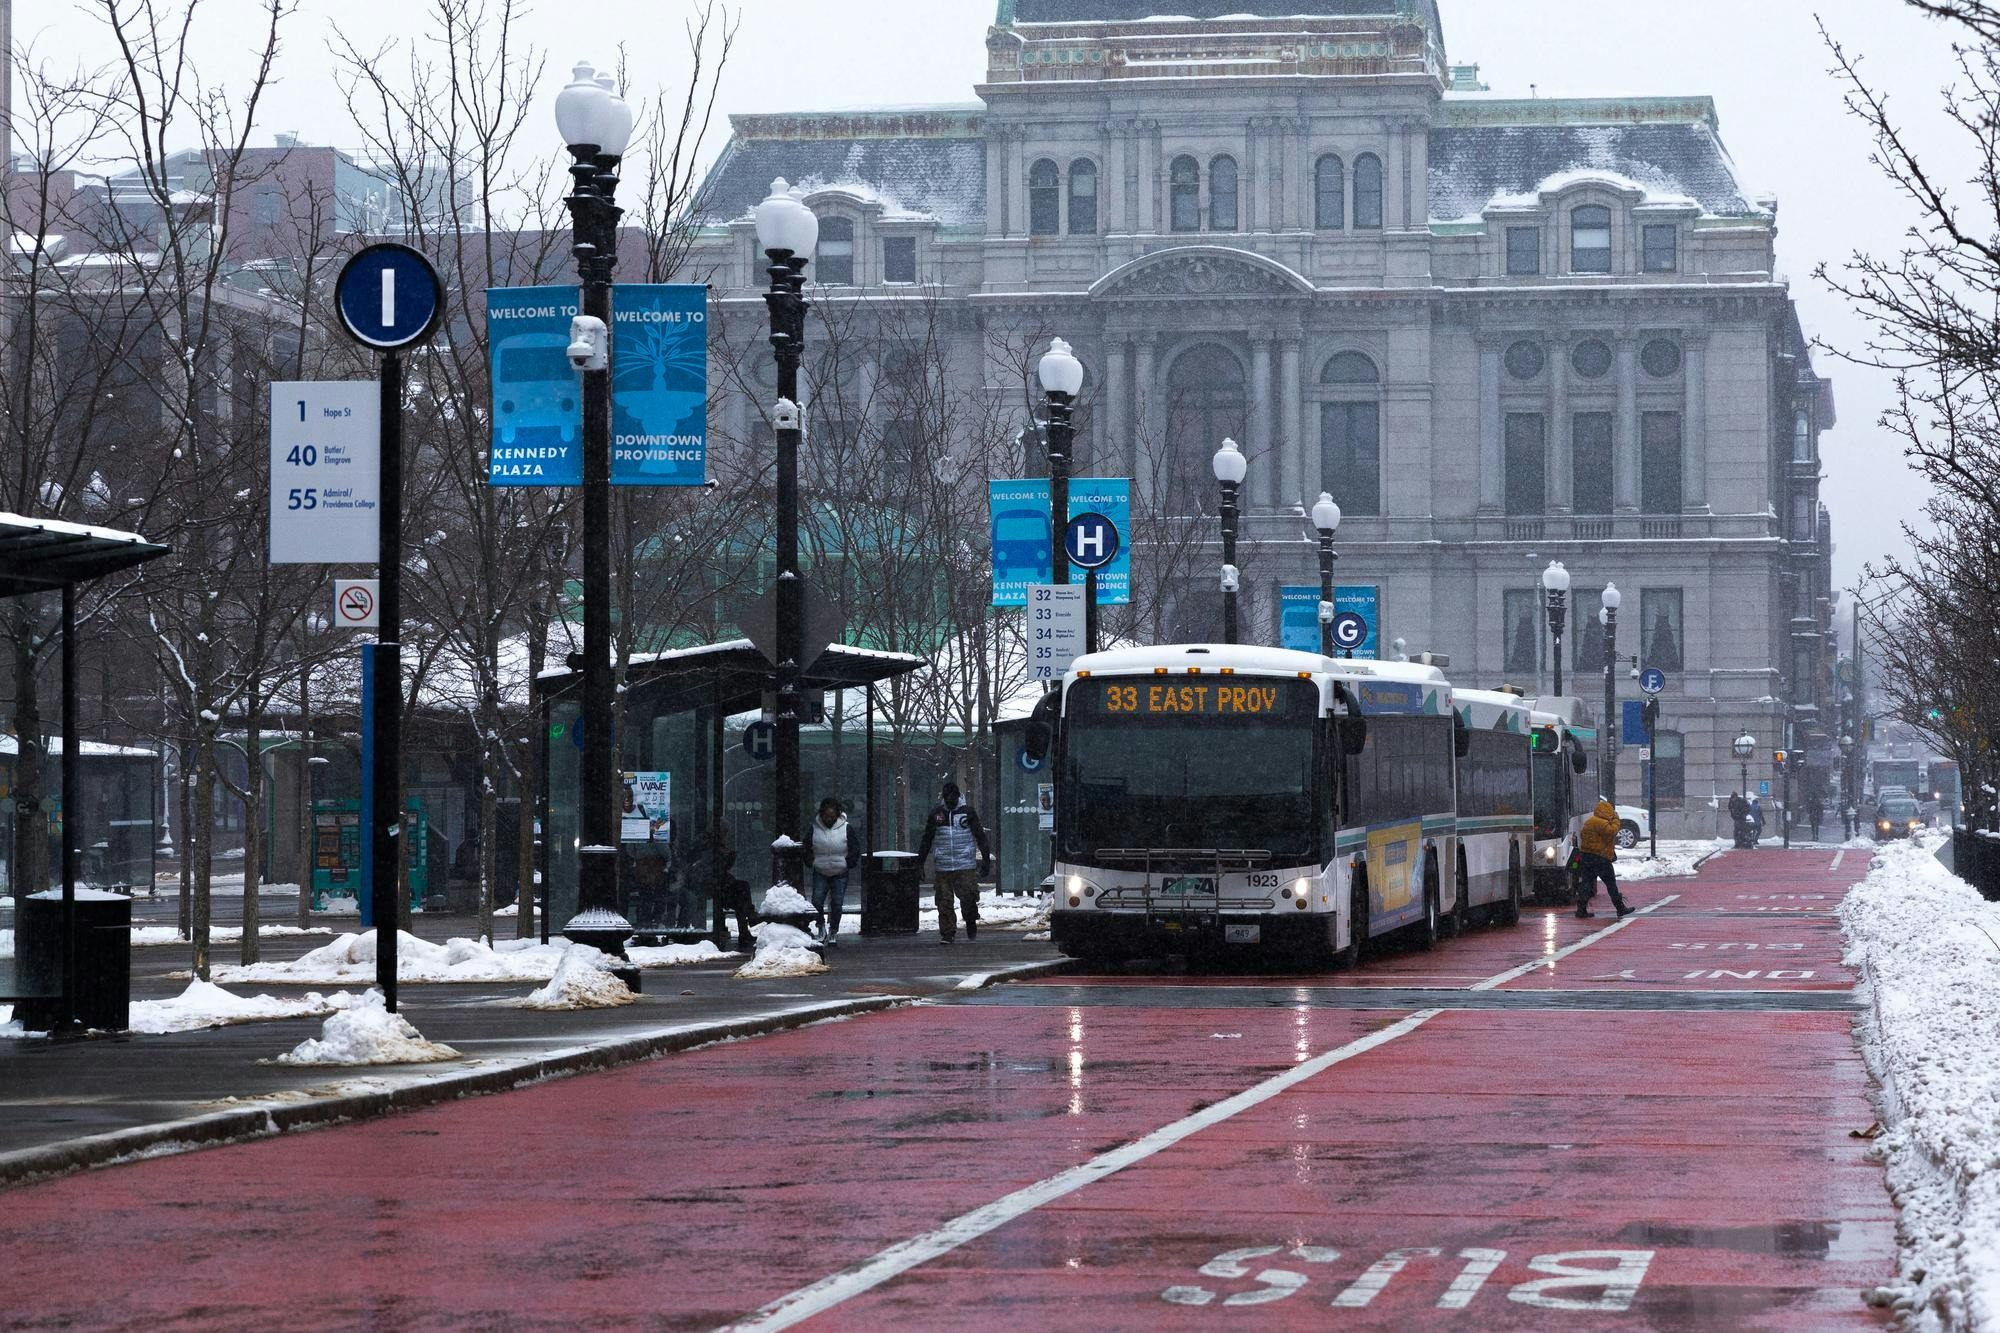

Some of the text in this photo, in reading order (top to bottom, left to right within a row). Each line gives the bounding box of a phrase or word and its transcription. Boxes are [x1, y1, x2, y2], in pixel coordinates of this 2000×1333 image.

[381, 268, 395, 327] I
[490, 305, 578, 320] WELCOME TO
[614, 311, 704, 323] WELCOME TO
[297, 400, 306, 422] 1
[323, 407, 352, 421] Hope St
[615, 434, 702, 446] DOWNTOWN
[286, 445, 317, 466] 40
[493, 446, 568, 460] KENNEDY
[615, 449, 702, 461] PROVIDENCE
[324, 456, 351, 466] Elmgrove
[492, 464, 544, 476] PLAZA
[287, 488, 317, 511] 55
[992, 492, 1035, 500] WELCOME
[1070, 495, 1128, 503] WELCOME TO
[322, 500, 376, 510] Providence College
[1077, 525, 1103, 556] H
[1071, 573, 1128, 581] DONTOWN
[993, 592, 1027, 600] PLAZA
[1035, 589, 1052, 601] 32
[1035, 608, 1052, 620] 33
[1035, 628, 1053, 640] 34
[1338, 620, 1358, 641] G
[1036, 647, 1052, 659] 35
[1036, 666, 1052, 678] 78
[1648, 674, 1657, 688] F
[1106, 686, 1276, 713] 33 EAST PROV
[752, 728, 773, 753] H
[640, 781, 667, 791] WAVE
[1246, 874, 1279, 888] 1923
[1667, 943, 1805, 951] BUS
[1160, 1245, 1656, 1312] BUS
